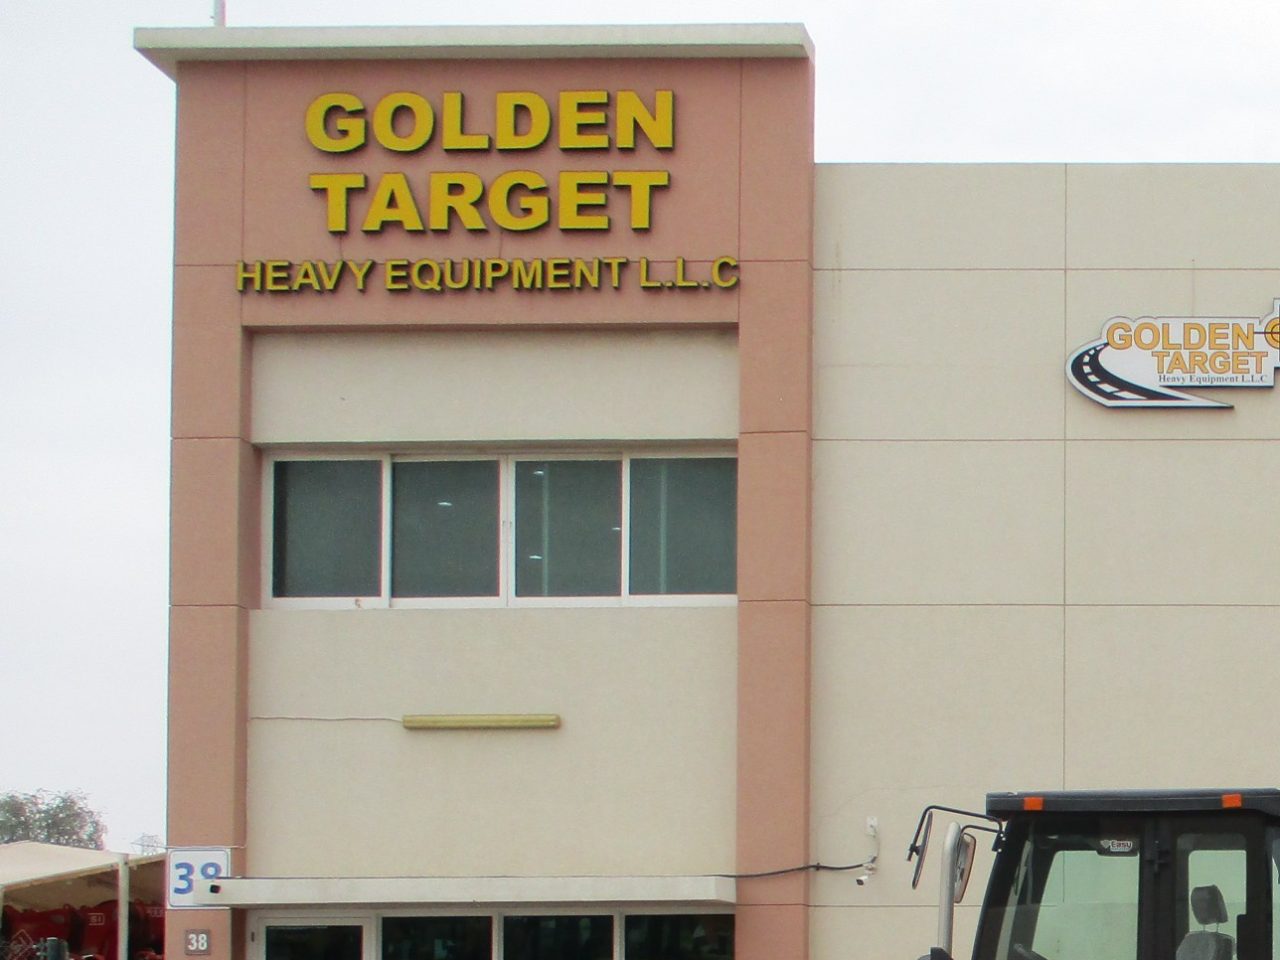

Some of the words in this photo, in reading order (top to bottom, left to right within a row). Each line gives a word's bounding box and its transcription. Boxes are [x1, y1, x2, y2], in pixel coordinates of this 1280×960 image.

[304, 90, 674, 153] GOLDEN
[309, 171, 669, 234] TARGET
[236, 261, 373, 292] HEAVY
[384, 258, 628, 291] EQUIPMENT
[638, 256, 740, 289] L.L.C
[1106, 321, 1254, 351] GOLDEN
[1152, 351, 1268, 374] TARGET
[1158, 374, 1187, 384] Heavy
[1189, 374, 1238, 384] Equipment
[188, 934, 208, 950] 38
